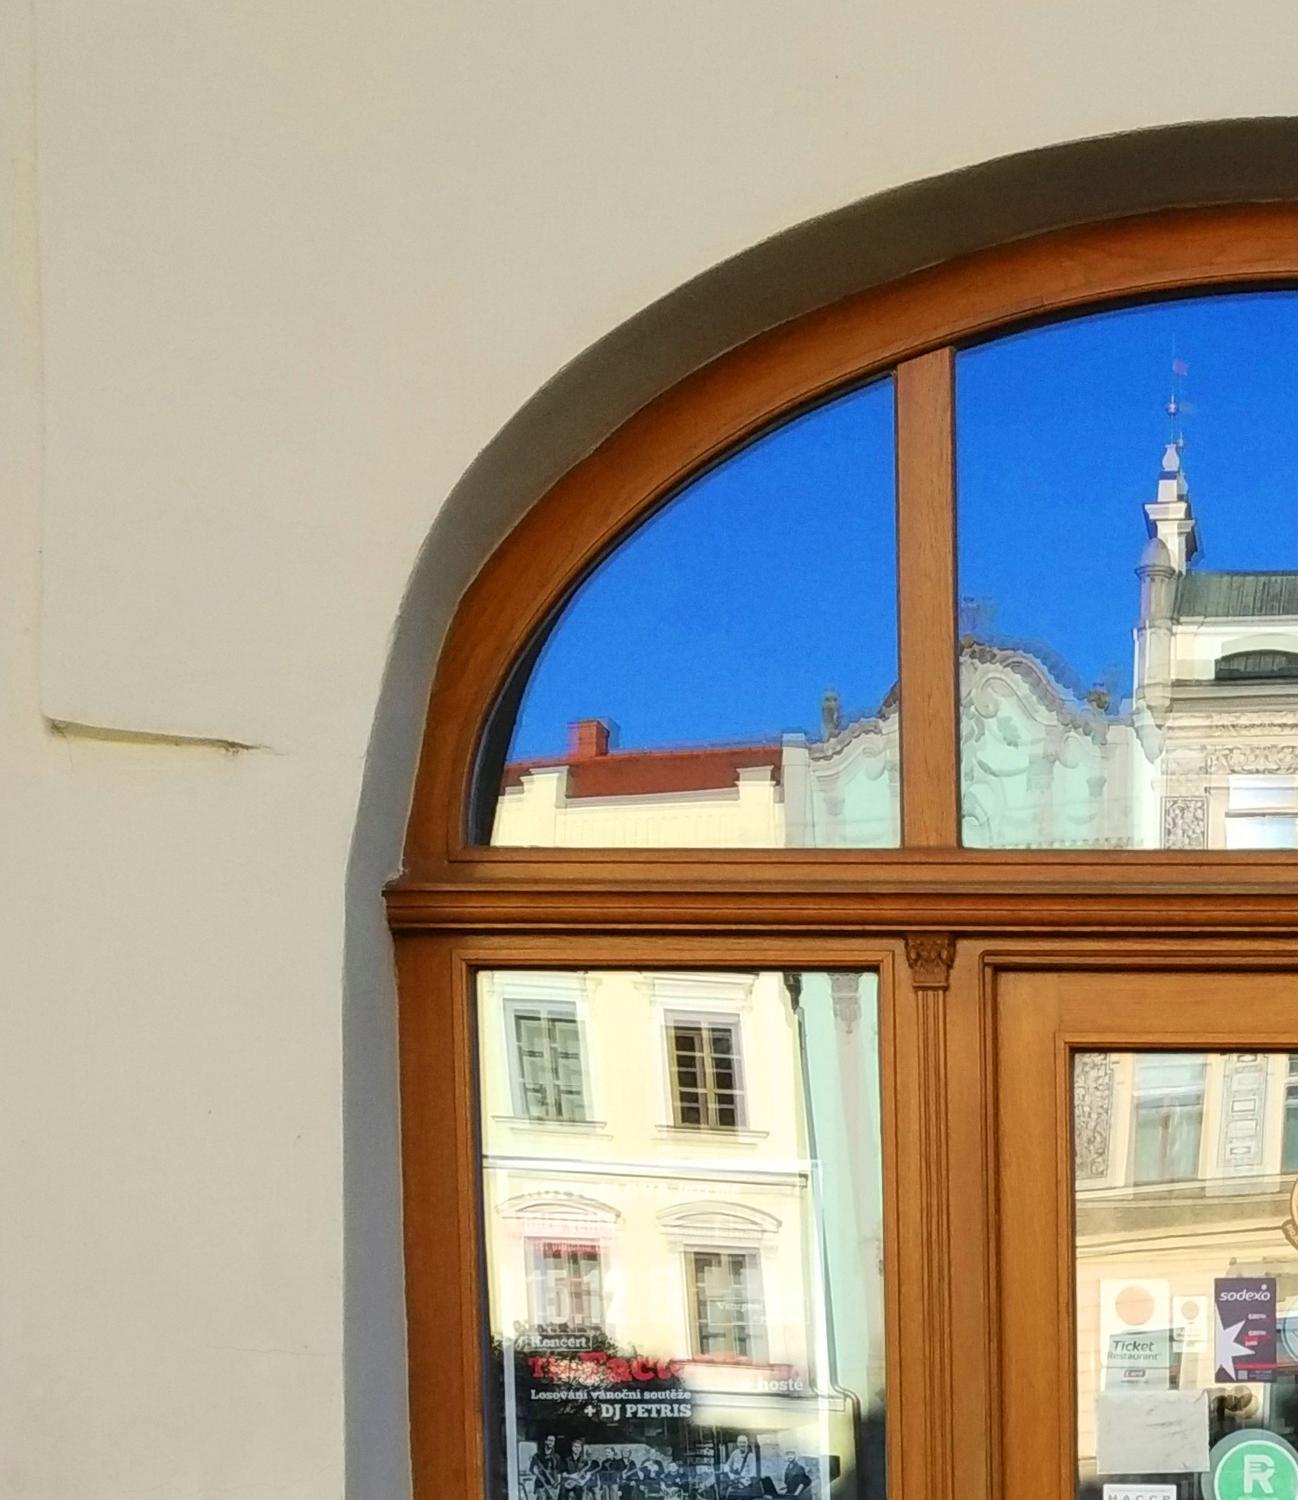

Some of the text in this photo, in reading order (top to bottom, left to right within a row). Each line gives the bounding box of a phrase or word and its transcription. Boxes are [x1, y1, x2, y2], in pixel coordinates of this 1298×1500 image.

[1219, 1286, 1271, 1302] sodexo
[531, 1336, 587, 1348] Koncert
[1113, 1340, 1155, 1352] Ticket
[590, 1389, 641, 1401] vánoční
[643, 1388, 691, 1400] soutěže
[601, 1404, 622, 1418] DJ
[625, 1403, 692, 1417] PETRIS
